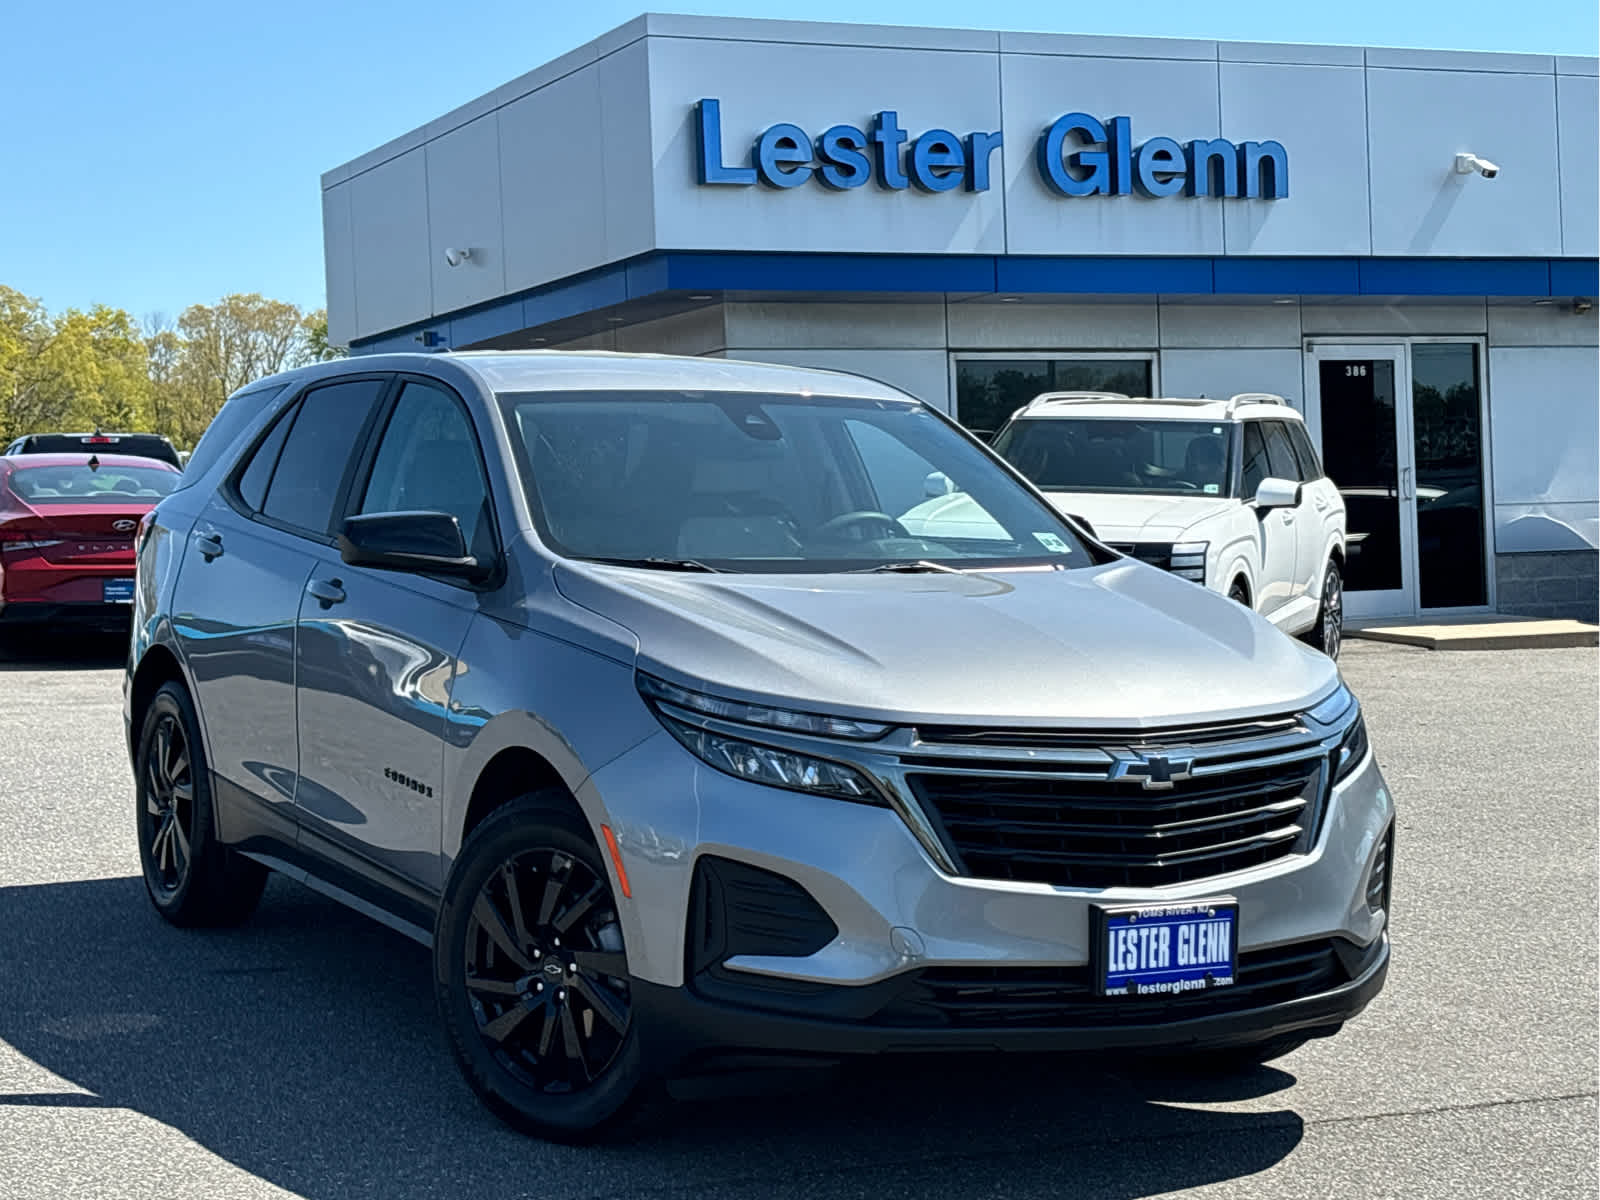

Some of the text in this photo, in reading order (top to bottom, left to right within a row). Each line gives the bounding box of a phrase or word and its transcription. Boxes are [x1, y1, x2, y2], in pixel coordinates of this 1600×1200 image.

[696, 97, 1289, 199] Lester Glenn
[1345, 365, 1367, 377] 386
[1108, 921, 1231, 972] LESTER GLENN
[1137, 979, 1206, 994] lesterglenn
